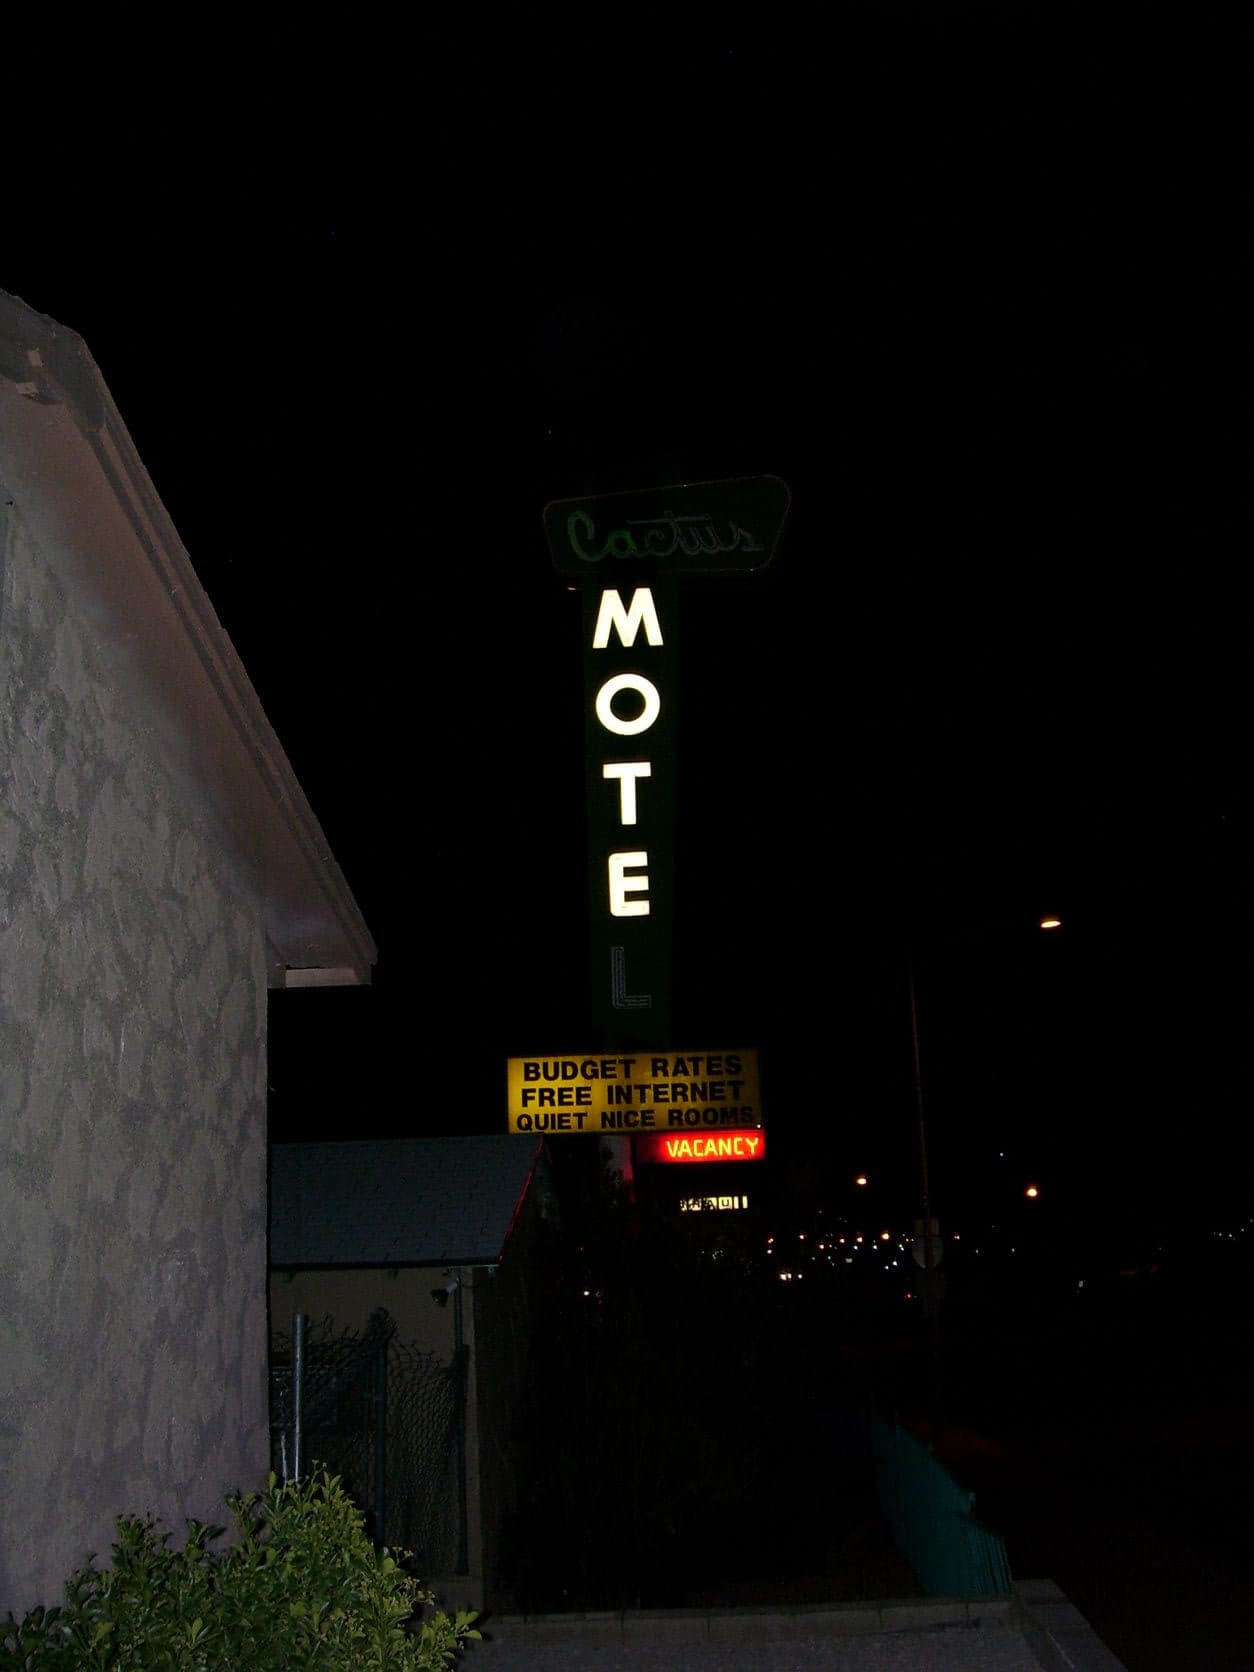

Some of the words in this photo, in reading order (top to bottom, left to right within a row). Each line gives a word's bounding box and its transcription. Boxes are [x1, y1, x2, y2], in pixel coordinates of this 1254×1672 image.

[567, 510, 765, 562] Cactus
[592, 586, 664, 1009] MOTEL
[523, 1060, 636, 1081] BUDGET
[651, 1056, 742, 1077] RATES
[521, 1086, 592, 1107] FREE
[607, 1081, 745, 1104] INTERNET
[517, 1112, 588, 1132] QUIET
[601, 1109, 656, 1129] NICE
[668, 1106, 754, 1126] ROOMS
[666, 1137, 760, 1158] VACANCY
